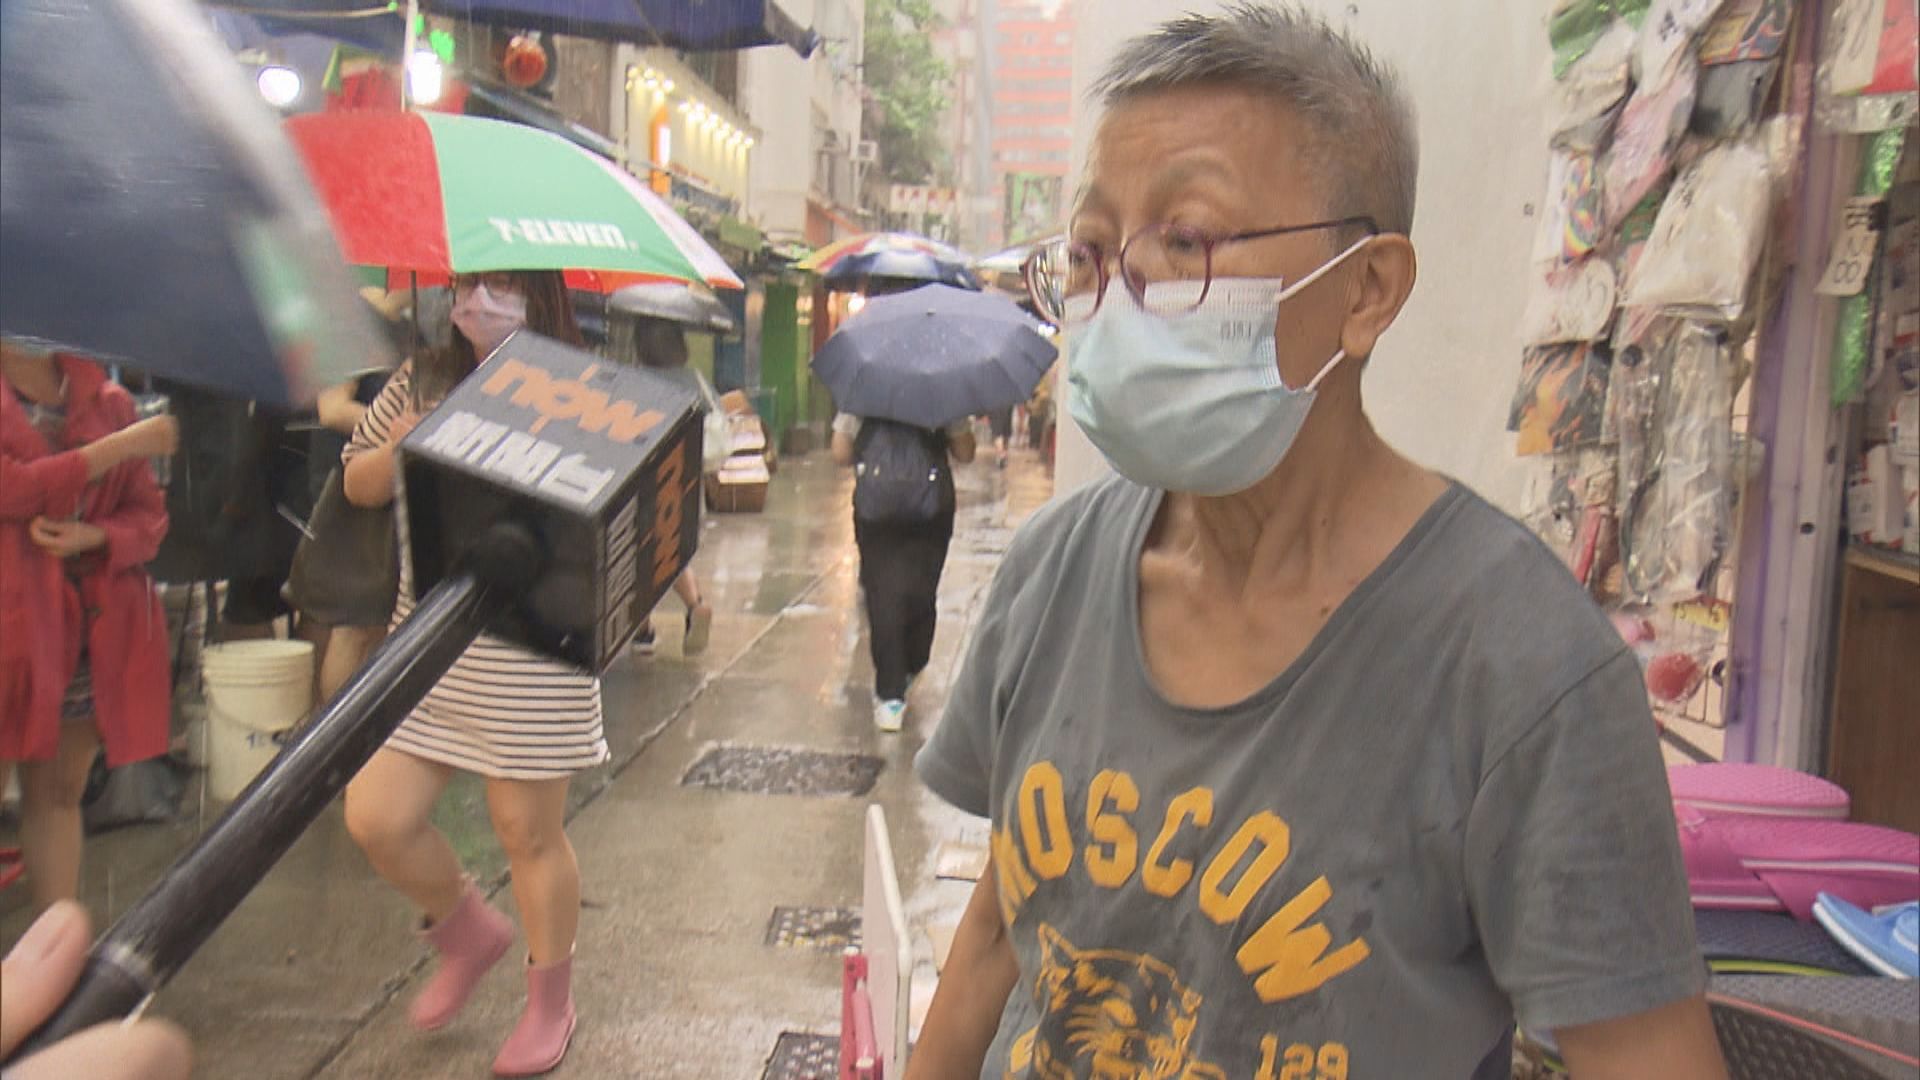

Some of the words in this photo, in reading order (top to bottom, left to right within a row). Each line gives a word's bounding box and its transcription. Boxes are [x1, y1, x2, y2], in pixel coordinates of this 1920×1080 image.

[480, 358, 666, 443] now
[645, 439, 695, 587] now
[1255, 1032, 1349, 1080] 129
